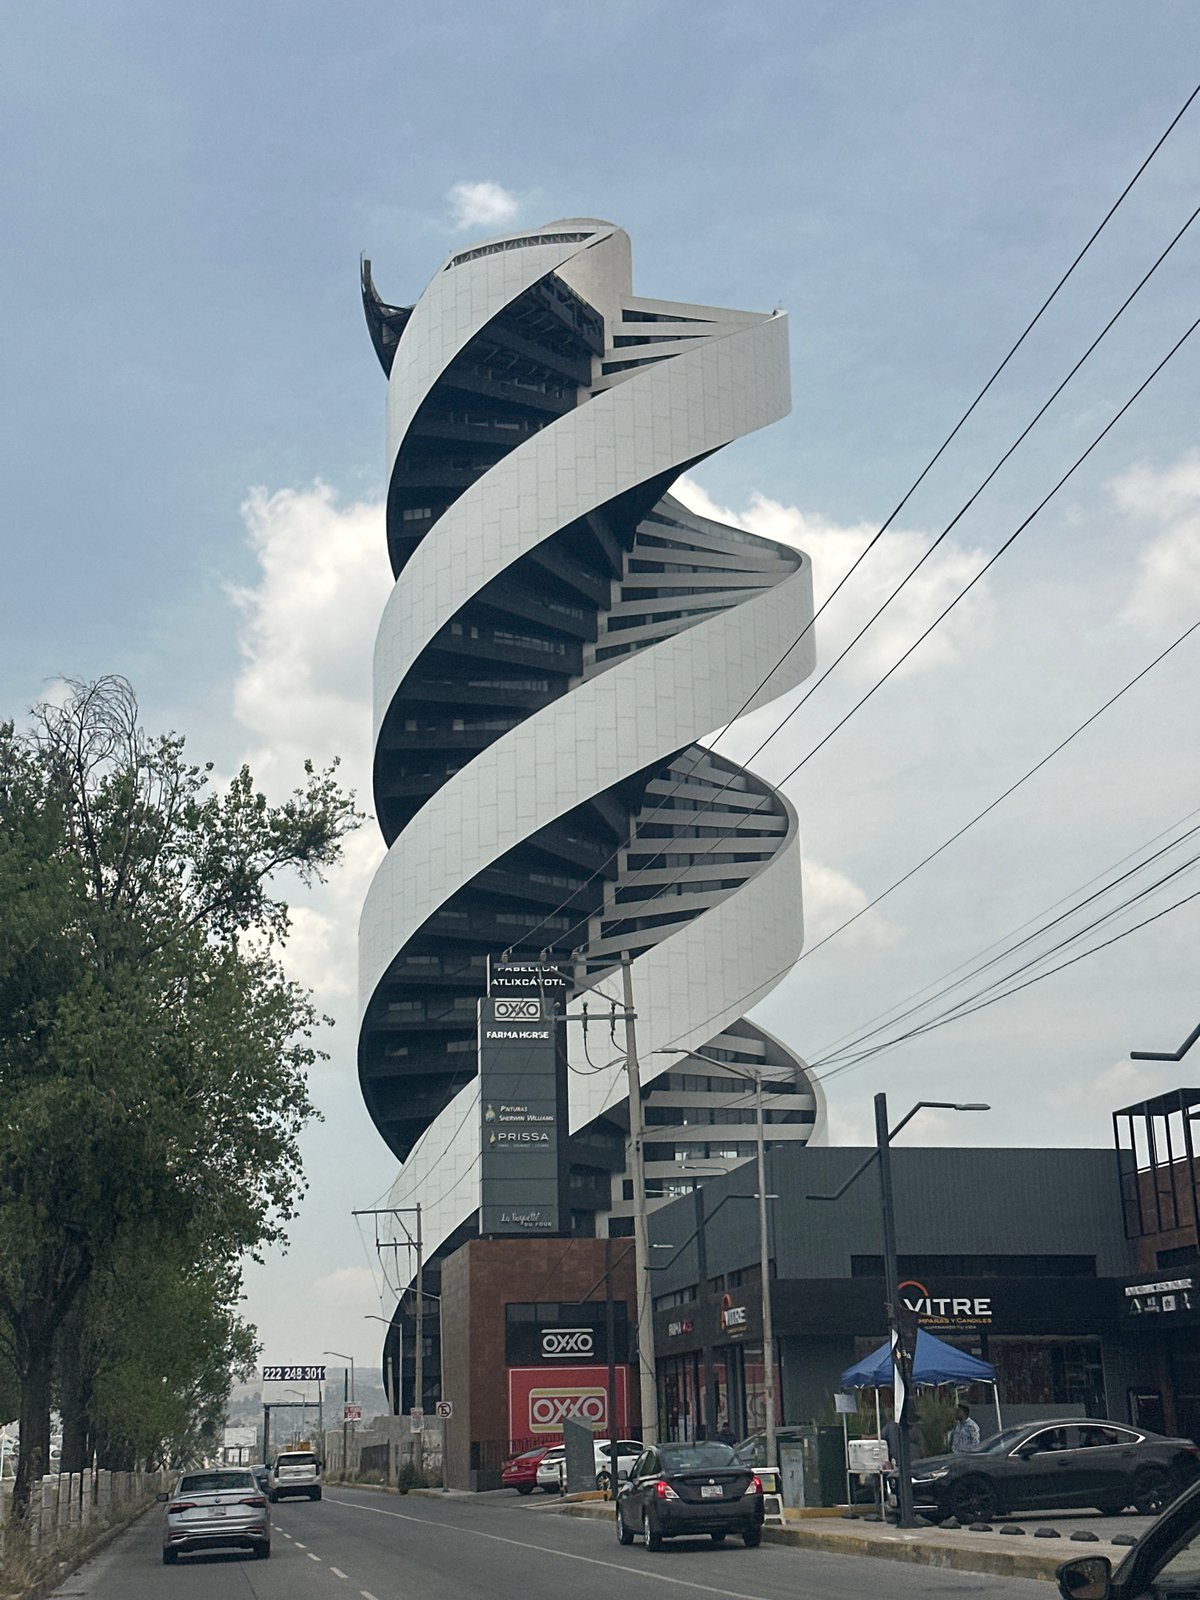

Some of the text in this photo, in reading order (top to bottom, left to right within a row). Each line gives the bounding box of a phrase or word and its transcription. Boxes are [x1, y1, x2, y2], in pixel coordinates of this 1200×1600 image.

[496, 1002, 539, 1018] OXXO
[498, 1132, 549, 1141] PRISSA
[903, 1298, 992, 1315] VITRE
[542, 1333, 593, 1352] OXXO
[263, 1367, 282, 1380] 222
[284, 1367, 303, 1380] 248
[533, 1396, 604, 1424] OXXO
